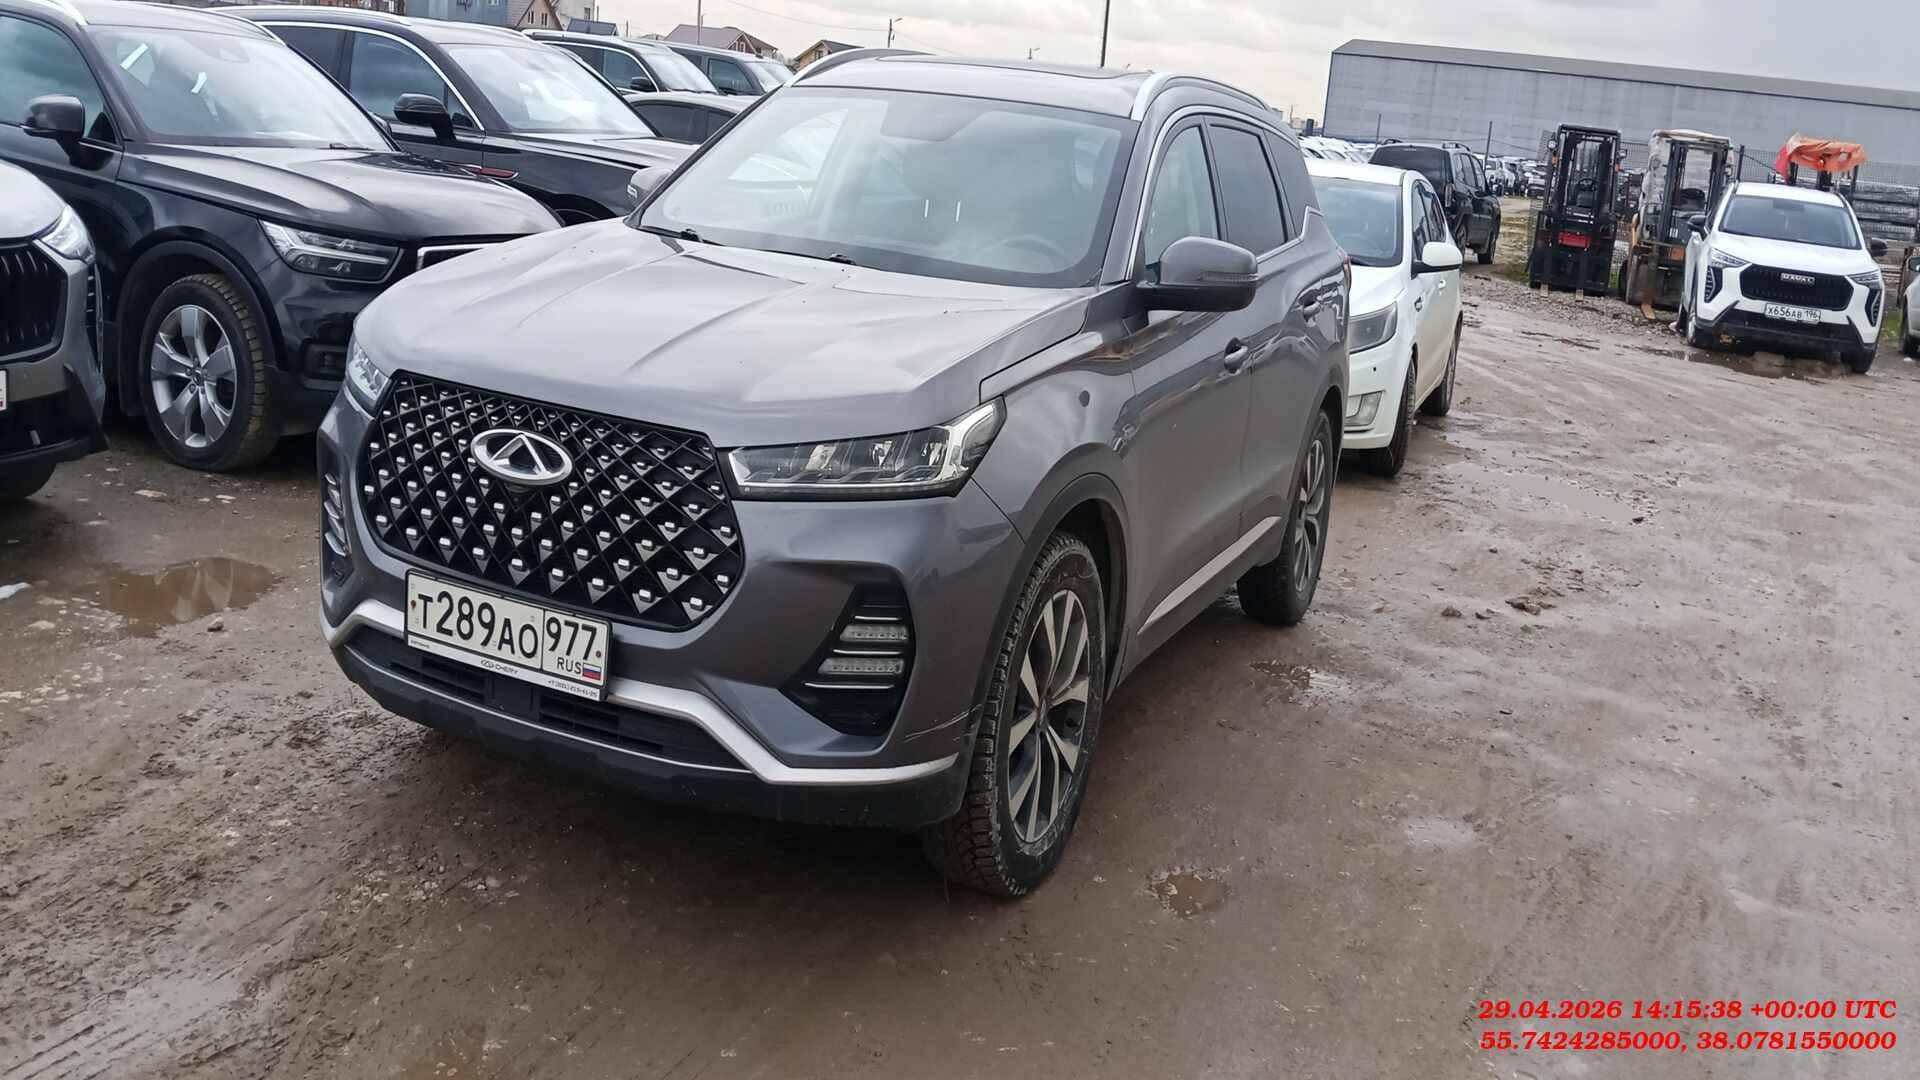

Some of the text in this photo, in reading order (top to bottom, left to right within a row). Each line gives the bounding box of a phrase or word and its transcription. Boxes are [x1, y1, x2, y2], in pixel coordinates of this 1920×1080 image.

[418, 591, 597, 660] Т289АО 977
[557, 657, 582, 675] RUS
